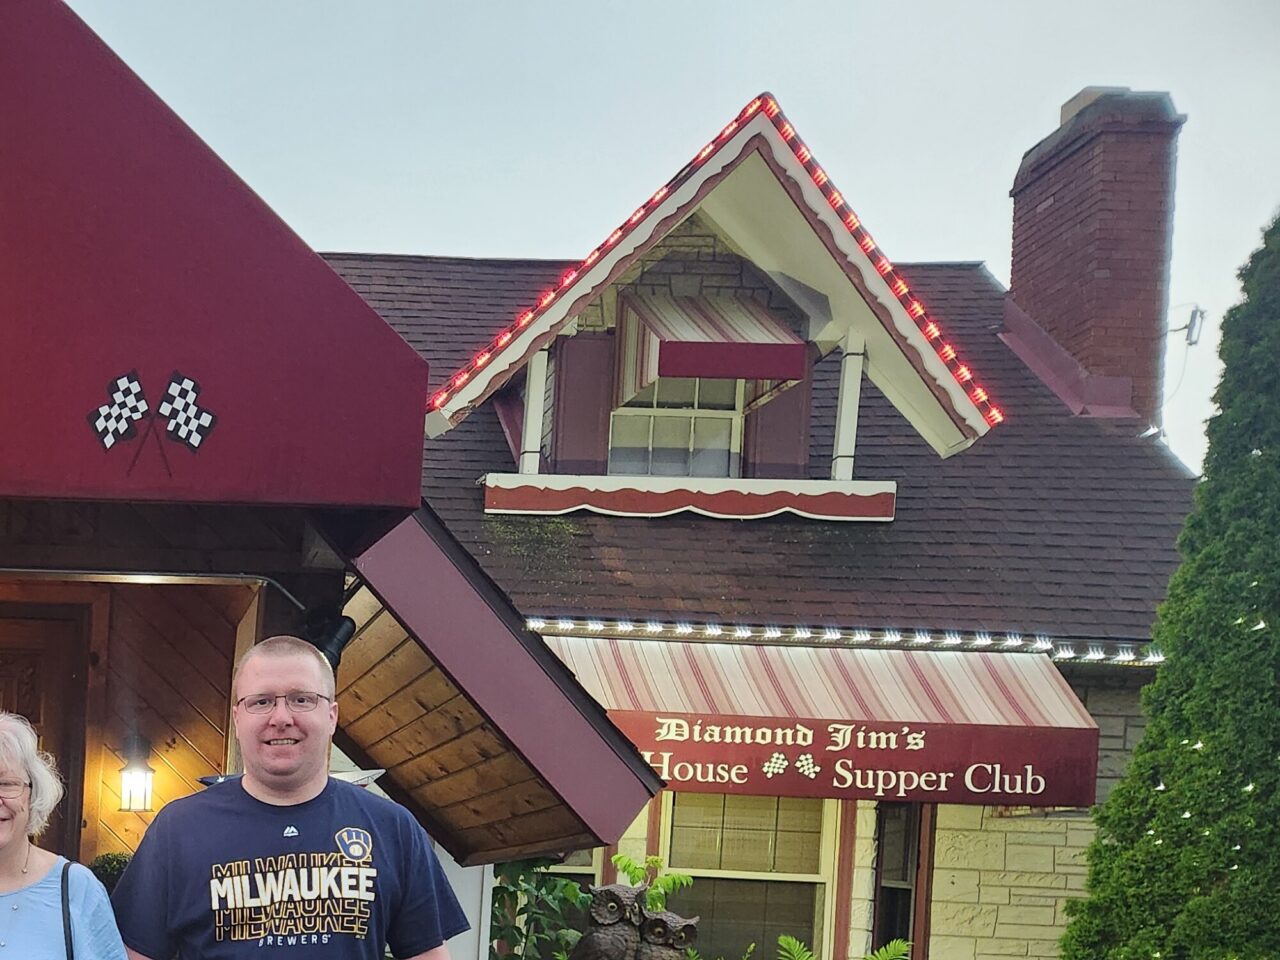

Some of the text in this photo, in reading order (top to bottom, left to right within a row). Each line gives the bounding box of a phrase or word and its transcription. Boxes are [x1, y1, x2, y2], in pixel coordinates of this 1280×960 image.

[655, 716, 927, 752] Diamond Jim's
[640, 751, 1047, 797] House Supper Club
[210, 867, 378, 911] MILWAUKEE
[258, 934, 329, 948] BREWERS
